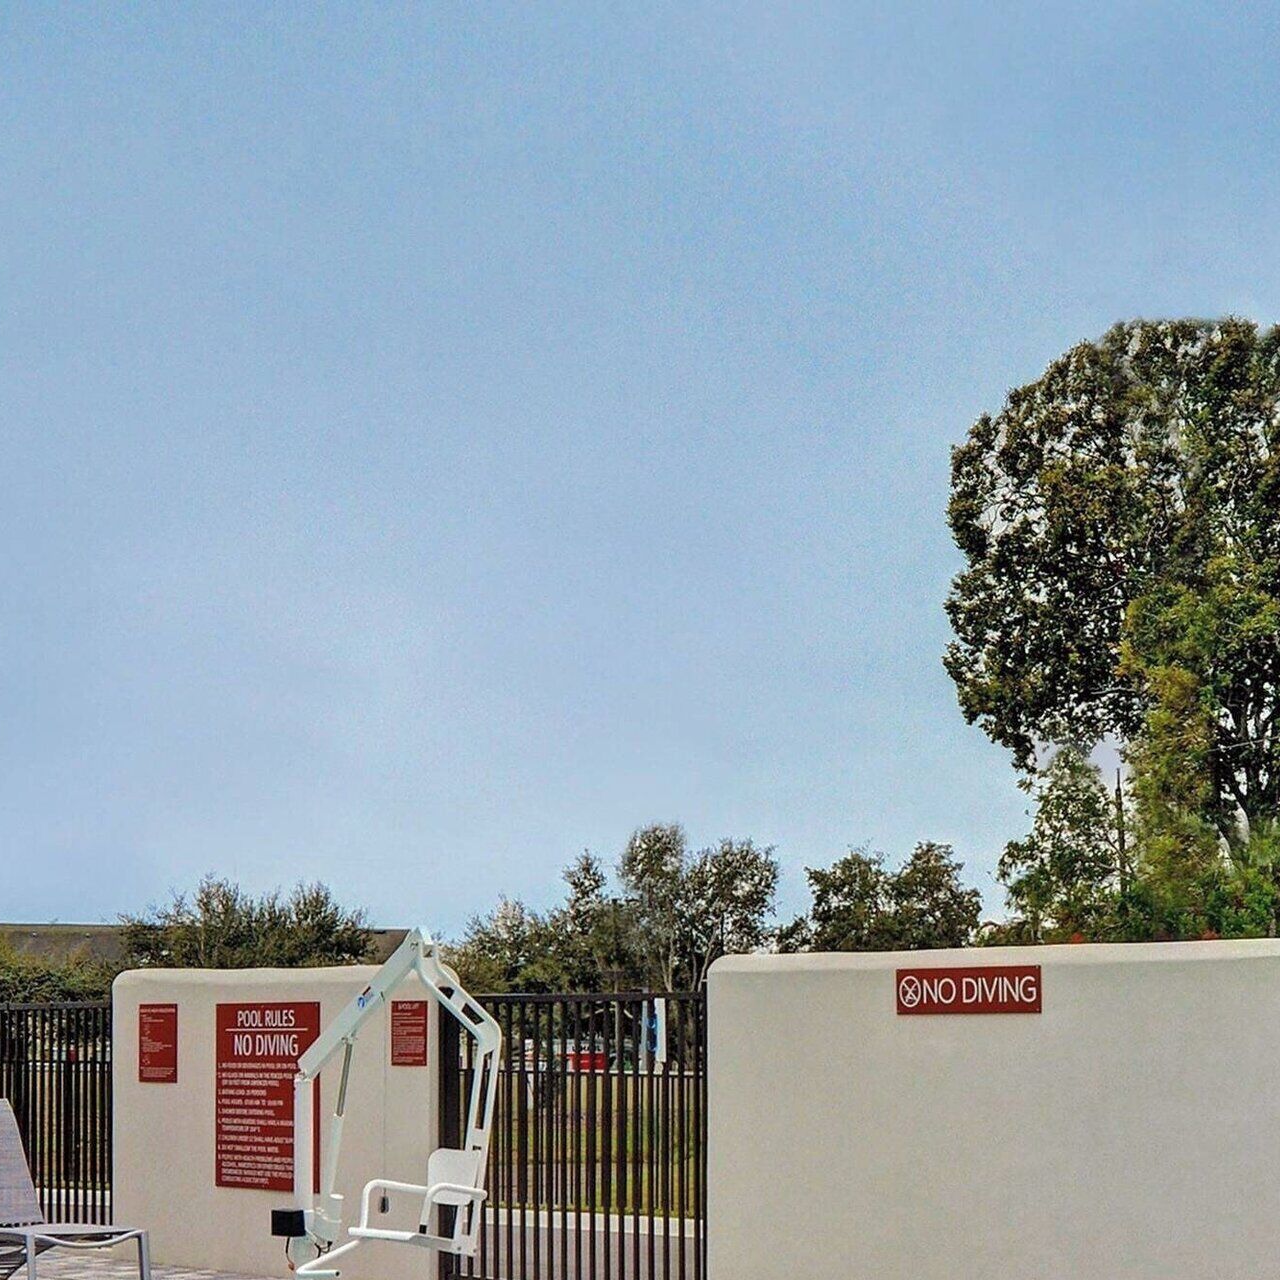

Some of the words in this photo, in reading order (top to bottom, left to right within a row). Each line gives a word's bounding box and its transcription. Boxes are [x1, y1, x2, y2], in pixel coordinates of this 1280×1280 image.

[922, 977, 957, 1004] NO
[962, 976, 1037, 1003] DIVING
[237, 1010, 263, 1027] POOL
[264, 1009, 295, 1027] RULES
[233, 1034, 252, 1056] NO
[255, 1034, 299, 1056] DIVING
